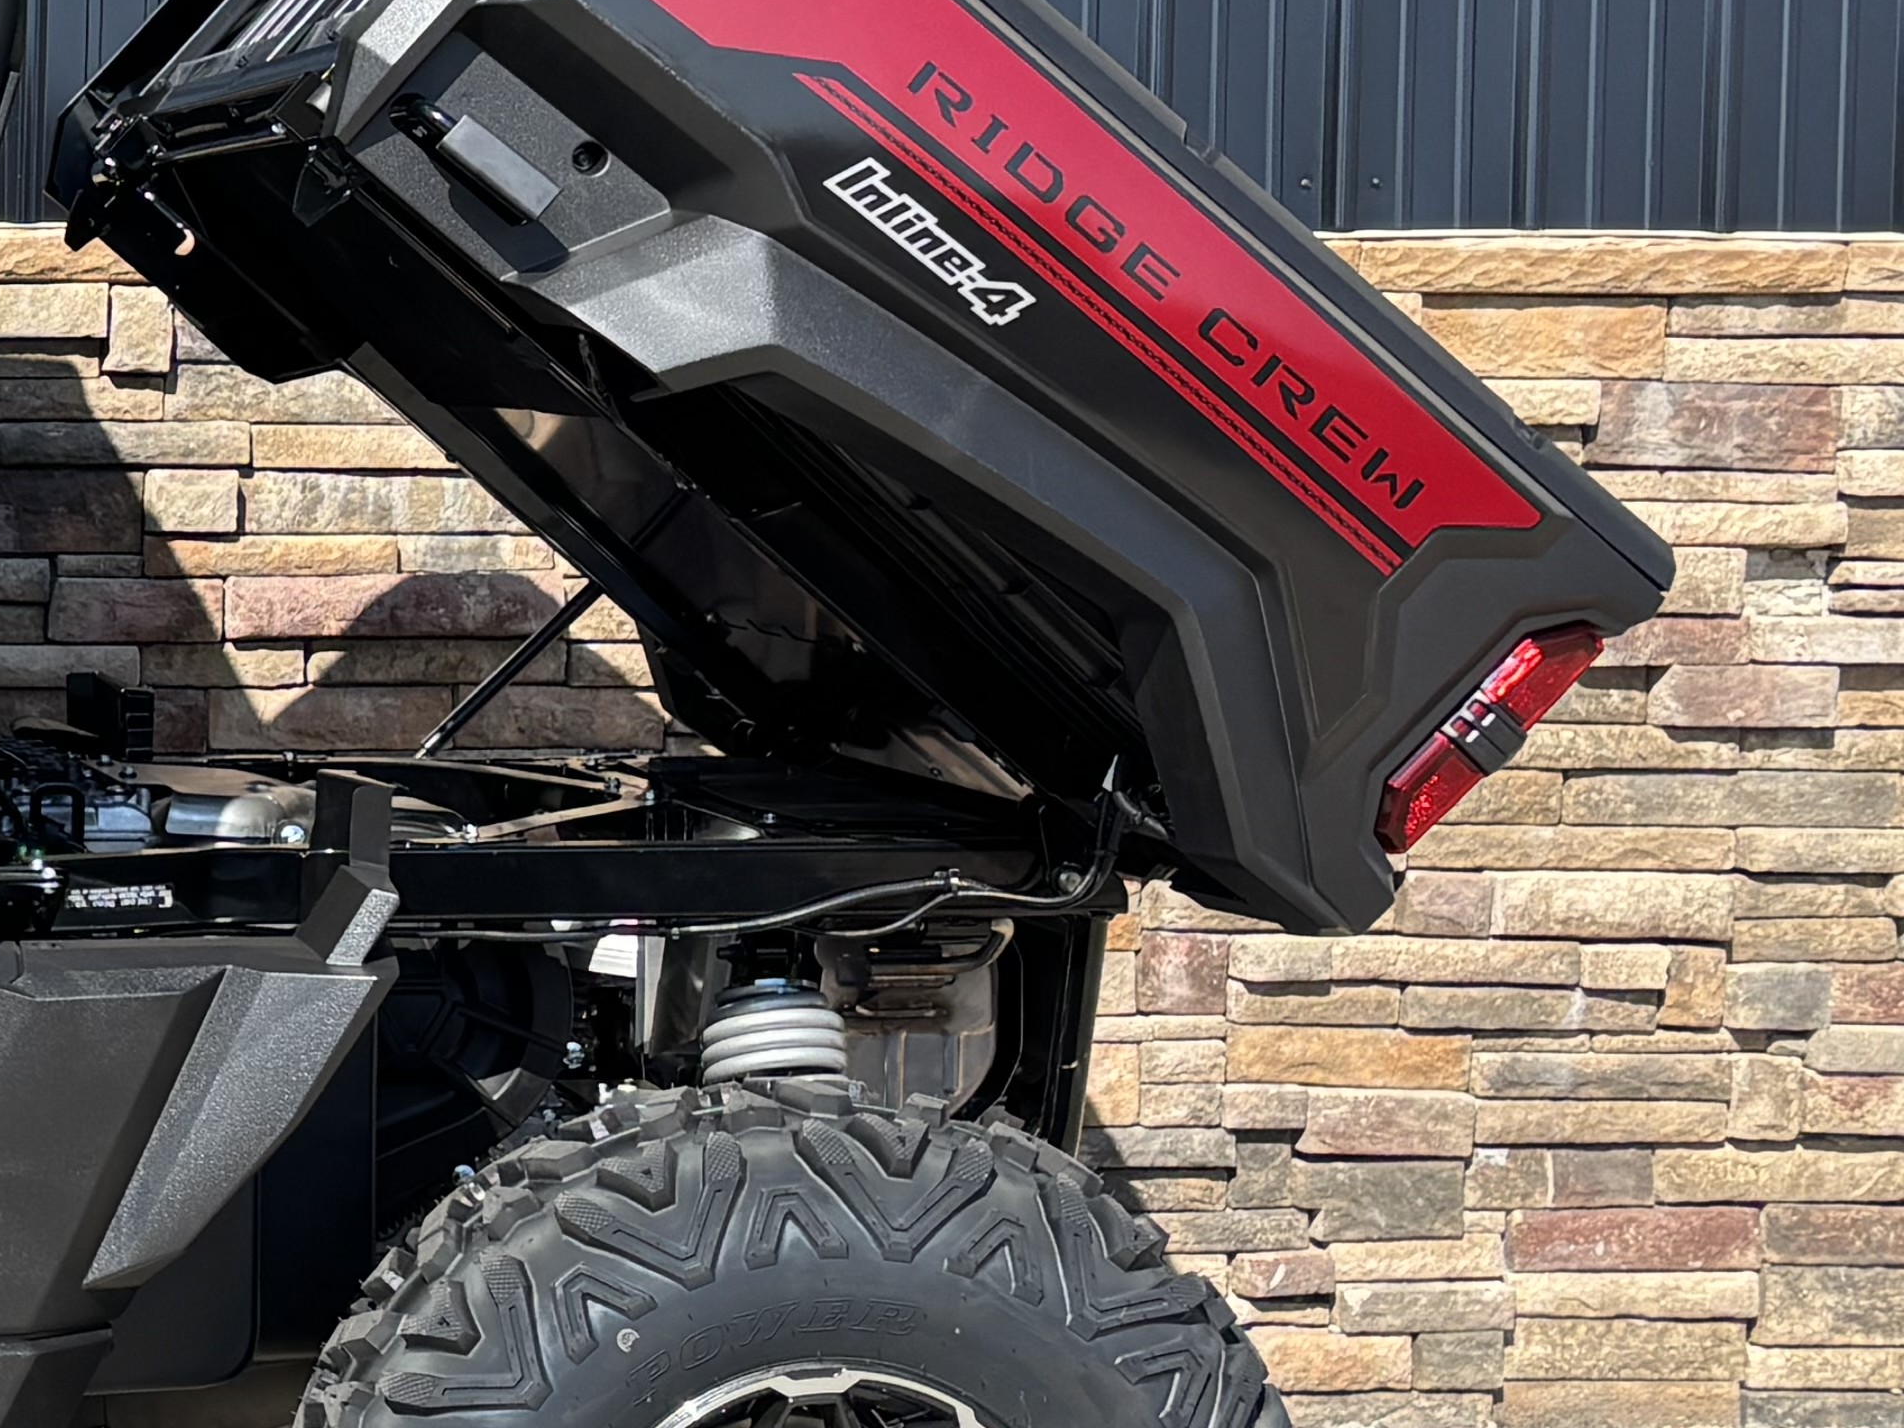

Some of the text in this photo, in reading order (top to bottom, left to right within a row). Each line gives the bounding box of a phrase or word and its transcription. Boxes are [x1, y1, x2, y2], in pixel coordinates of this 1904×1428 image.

[822, 156, 1037, 326] Inline-4
[907, 60, 1425, 510] RIDGE CREW
[625, 1297, 924, 1407] POWER
